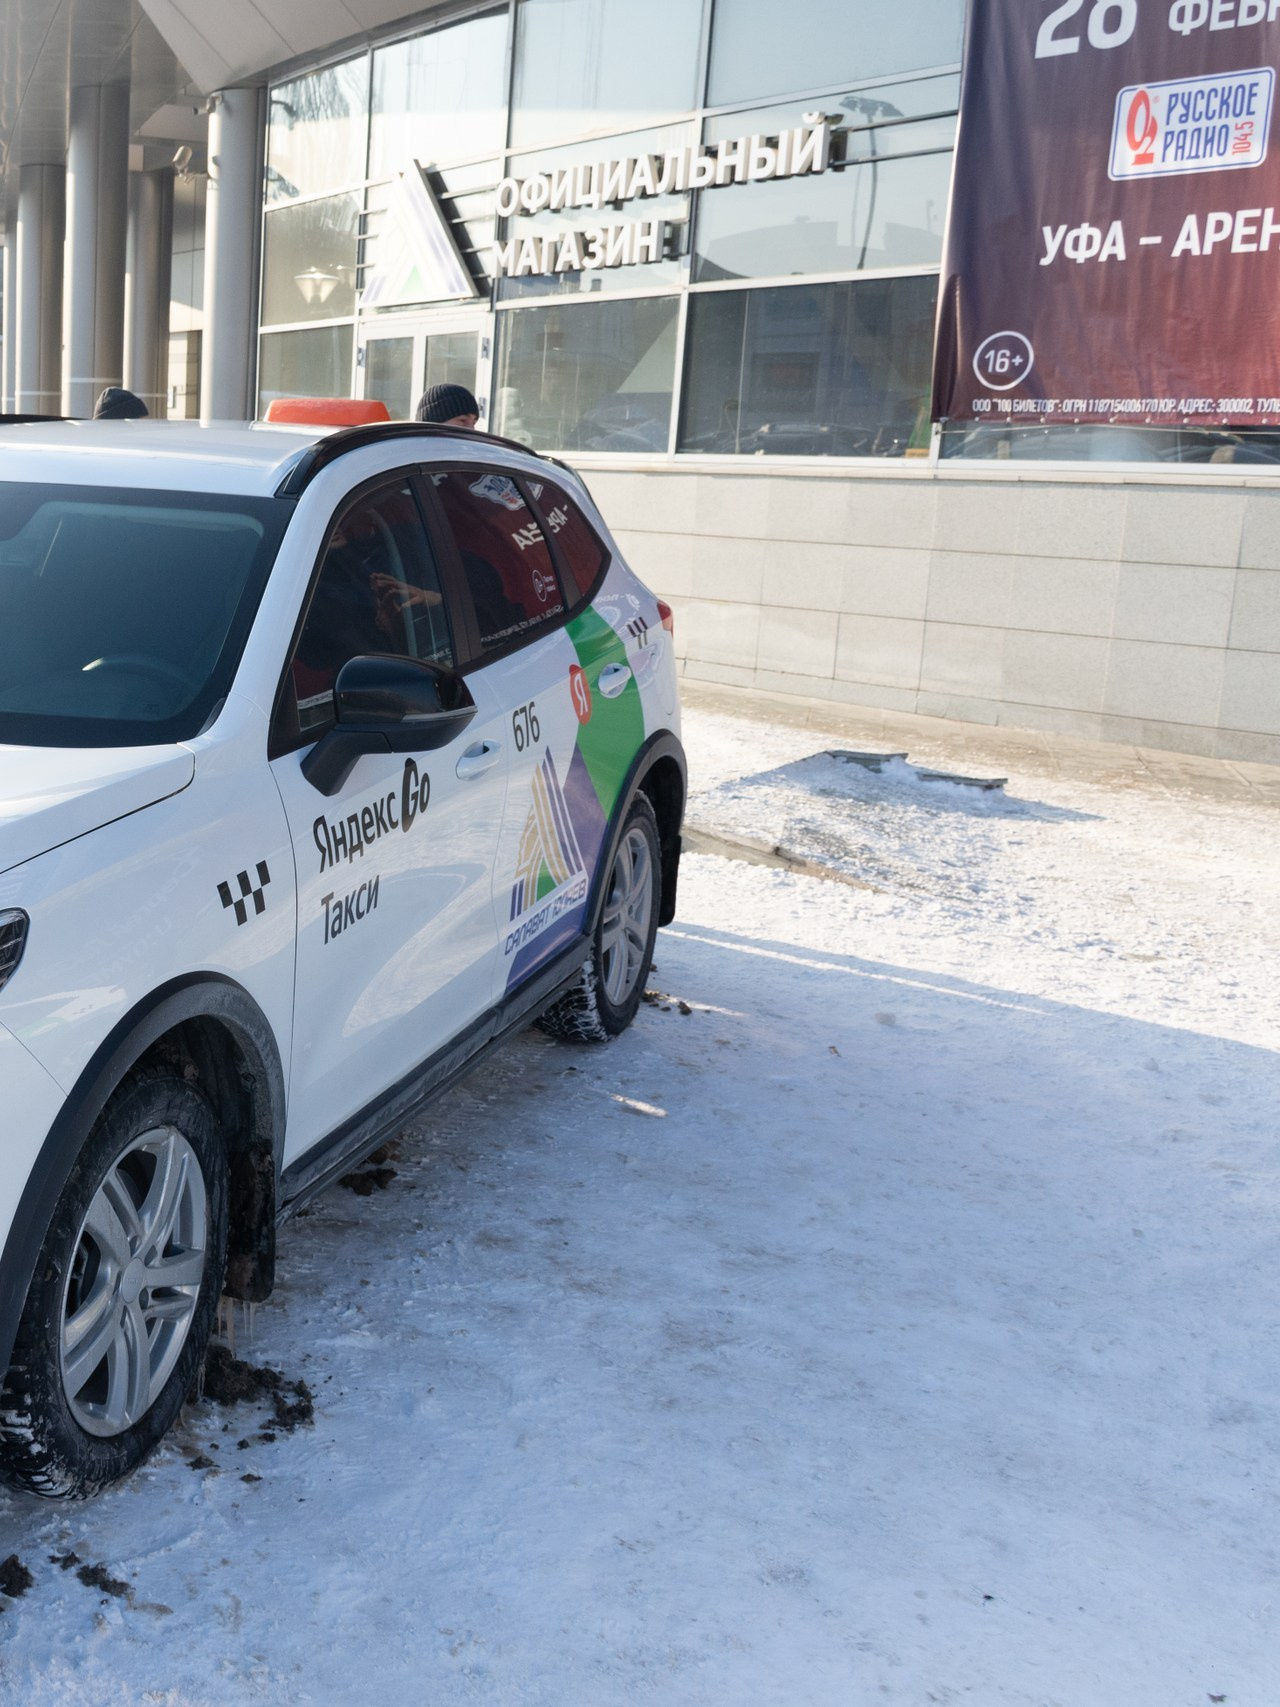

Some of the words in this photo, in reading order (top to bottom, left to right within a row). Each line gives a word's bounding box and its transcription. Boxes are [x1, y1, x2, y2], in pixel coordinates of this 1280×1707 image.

[1168, 0, 1280, 36] ФЕБ
[1165, 82, 1259, 126] РУССКОЕ
[1161, 124, 1230, 163] РАДИО
[1231, 120, 1254, 156] 104.5
[495, 111, 831, 218] ОФИЦИАЛЬНЫЙ
[490, 219, 668, 279] МАГАЗИН
[1039, 220, 1127, 266] УФА
[1171, 207, 1280, 258] АРЕН
[984, 349, 1024, 373] 16+
[1062, 398, 1087, 413] ОГРН
[1177, 398, 1216, 415] АДРЕС:
[574, 672, 589, 716] Я
[512, 701, 540, 752] 676
[313, 791, 399, 874] Яндекс
[401, 757, 431, 833] Go
[320, 875, 380, 945] Такси
